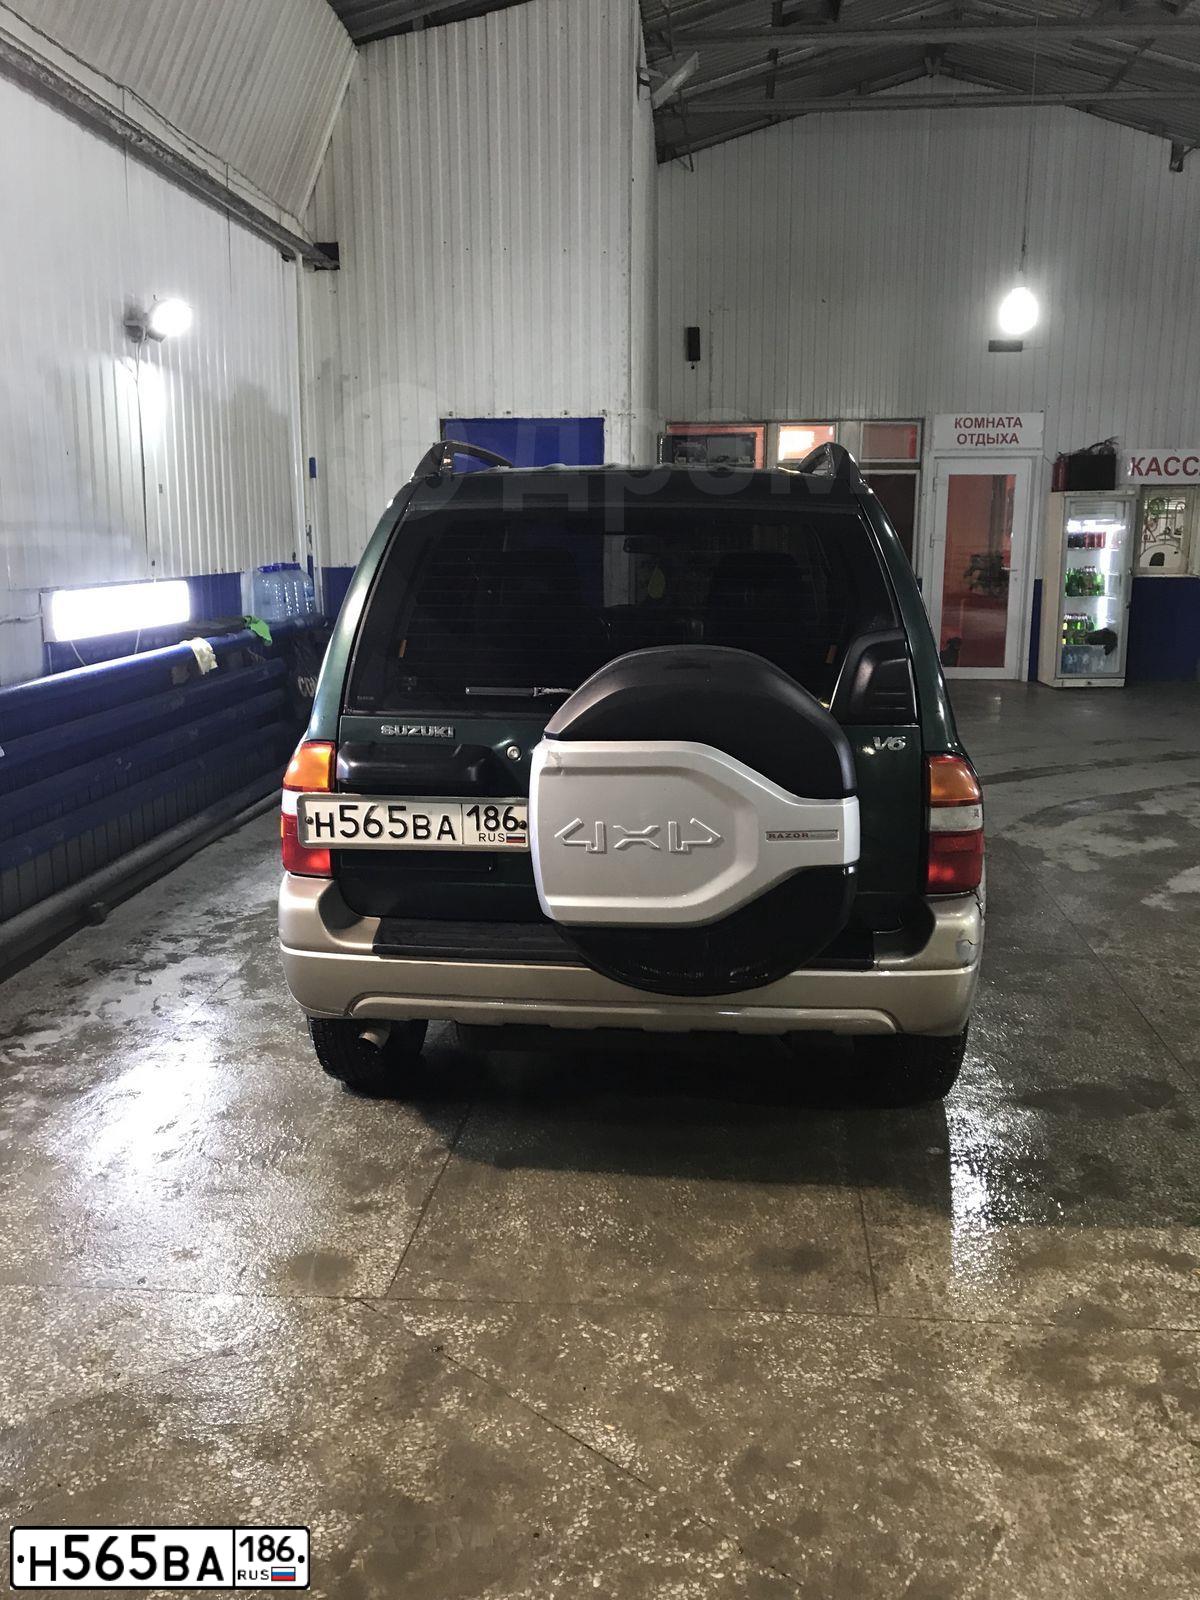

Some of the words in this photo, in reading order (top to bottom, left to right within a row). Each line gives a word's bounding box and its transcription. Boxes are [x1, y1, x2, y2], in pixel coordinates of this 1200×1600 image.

[954, 416, 1023, 429] КОМНАТА
[956, 432, 1020, 447] ОТДЫХА
[1130, 456, 1200, 476] КАСС
[380, 725, 454, 738] SUZUKI
[872, 736, 906, 750] V6
[314, 804, 456, 841] Н565ВА
[466, 804, 519, 832] 186
[478, 832, 505, 843] RUS
